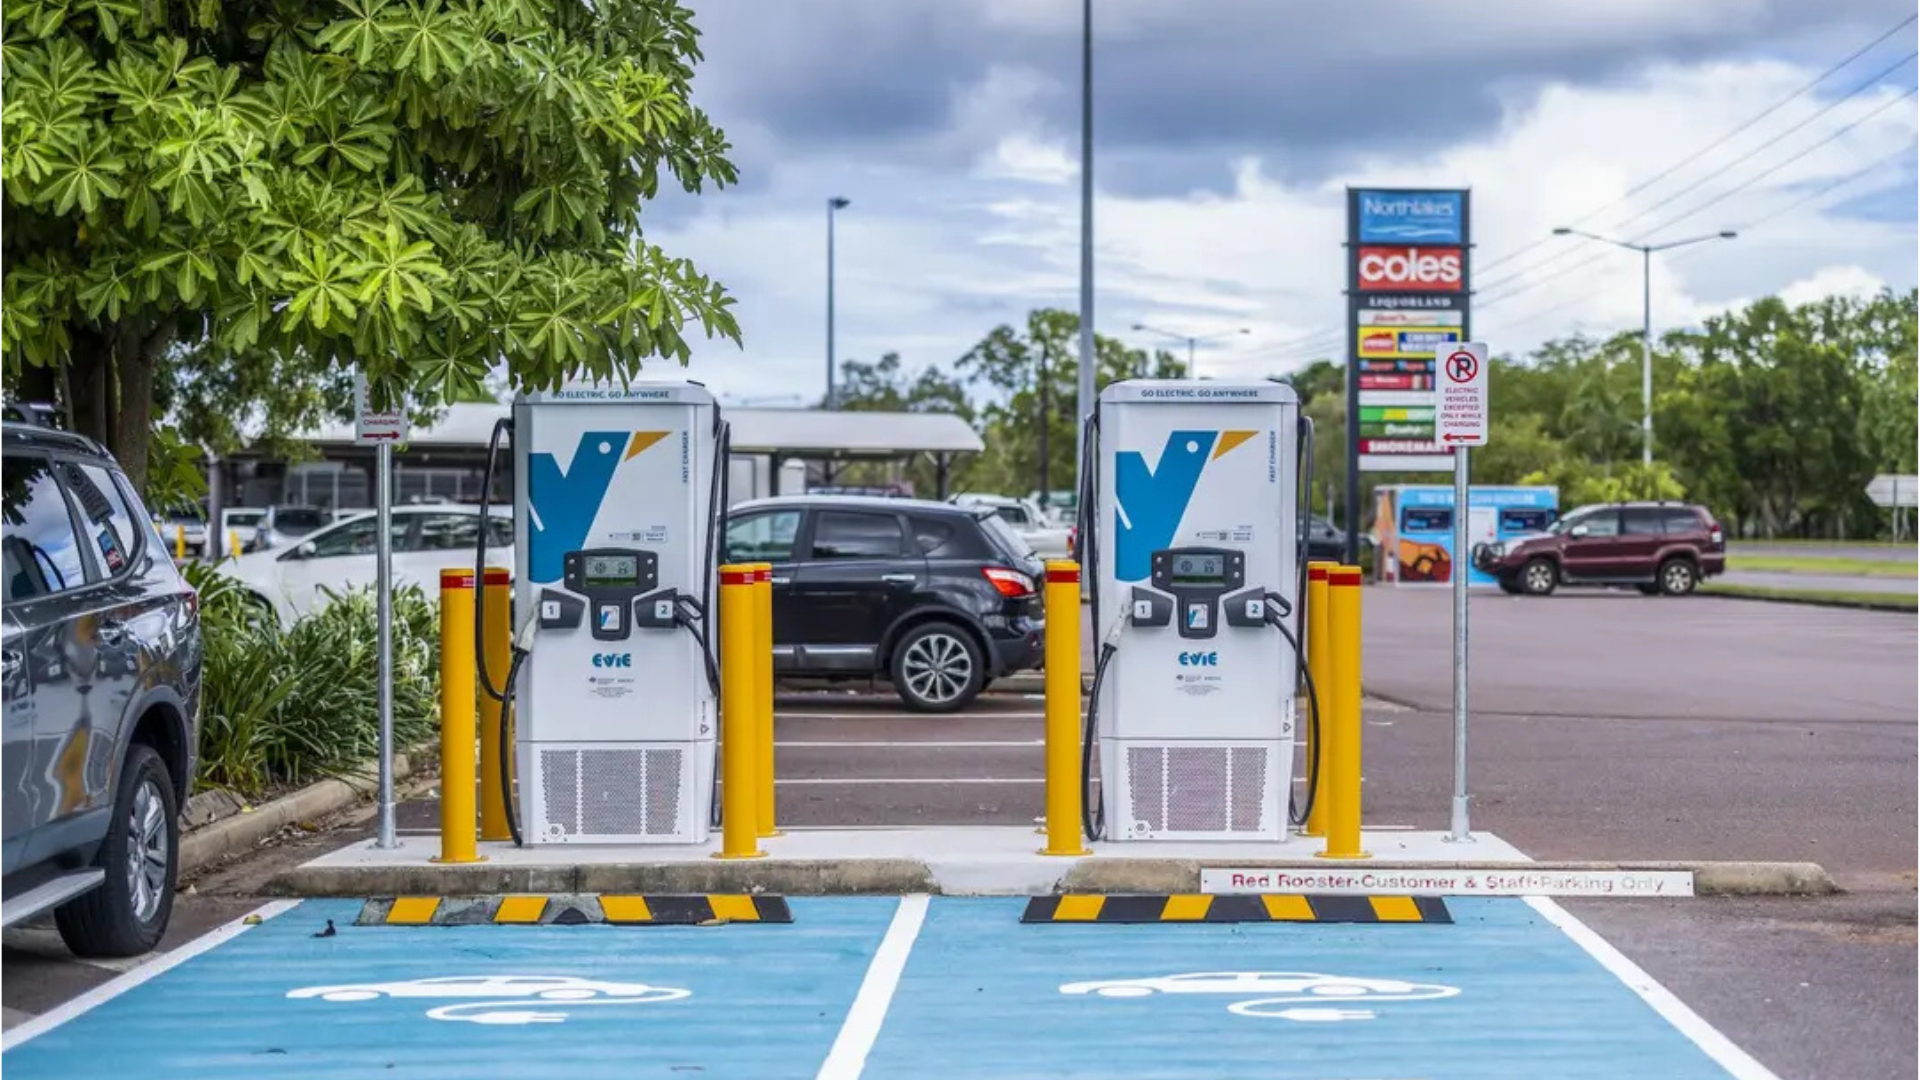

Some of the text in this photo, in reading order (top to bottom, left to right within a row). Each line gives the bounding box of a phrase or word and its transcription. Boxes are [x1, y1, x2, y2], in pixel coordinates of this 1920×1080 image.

[1360, 249, 1461, 282] coles
[608, 390, 621, 399] GO
[1141, 389, 1154, 398] GO
[1198, 389, 1211, 398] GO
[1212, 389, 1259, 398] ANYWHERE
[661, 605, 668, 615] 2
[1140, 605, 1146, 615] 1
[1251, 604, 1259, 614] 2
[1231, 874, 1665, 892] Red Rooster Customer & Staff Parking Only
